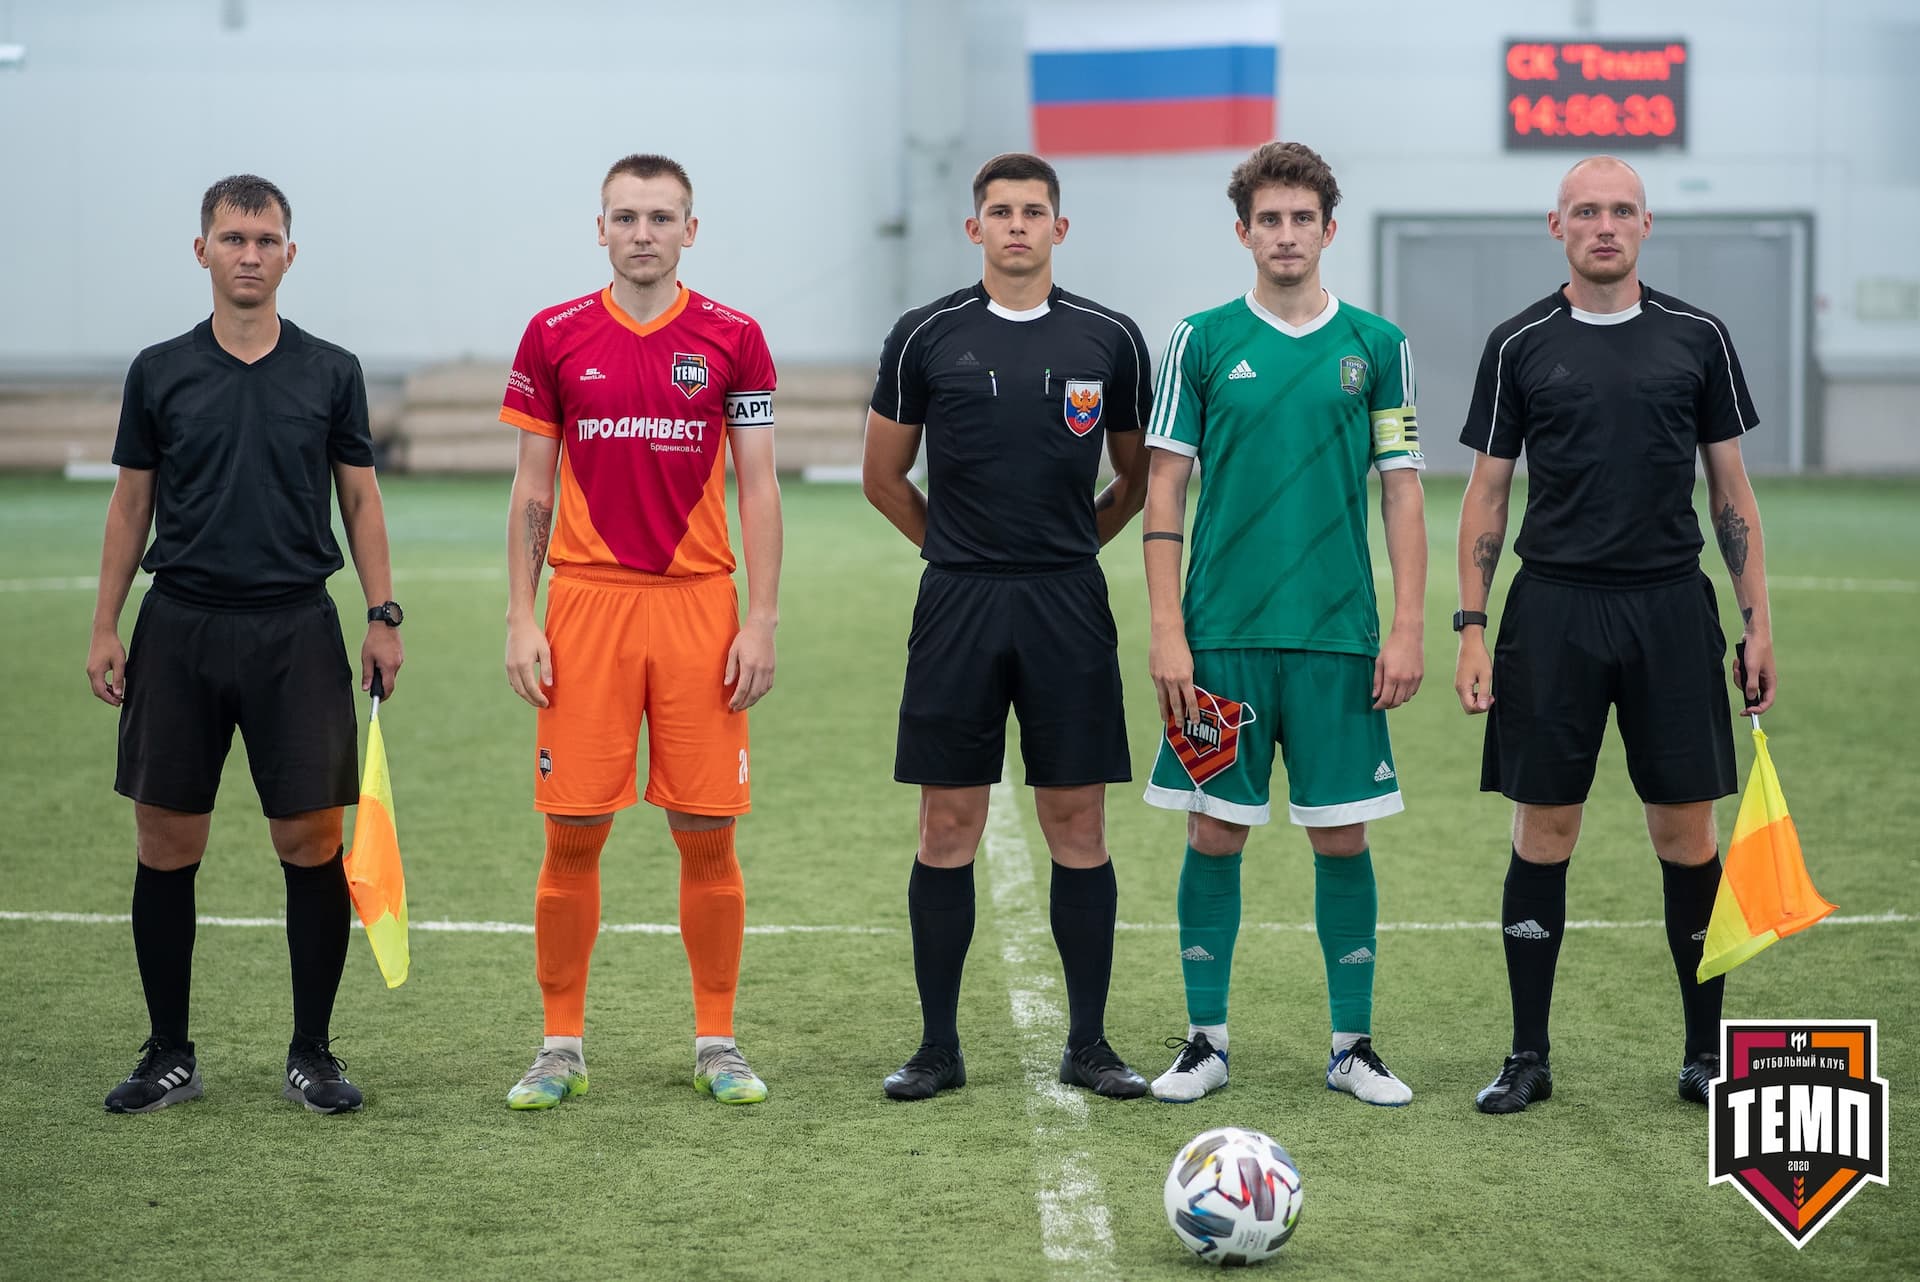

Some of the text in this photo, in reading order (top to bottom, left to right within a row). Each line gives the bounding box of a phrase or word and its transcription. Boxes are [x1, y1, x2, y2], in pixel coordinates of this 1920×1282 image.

[675, 365, 706, 384] ТЕМП
[577, 416, 707, 442] ПРОДИНВЕСТ
[1503, 926, 1550, 940] adidas
